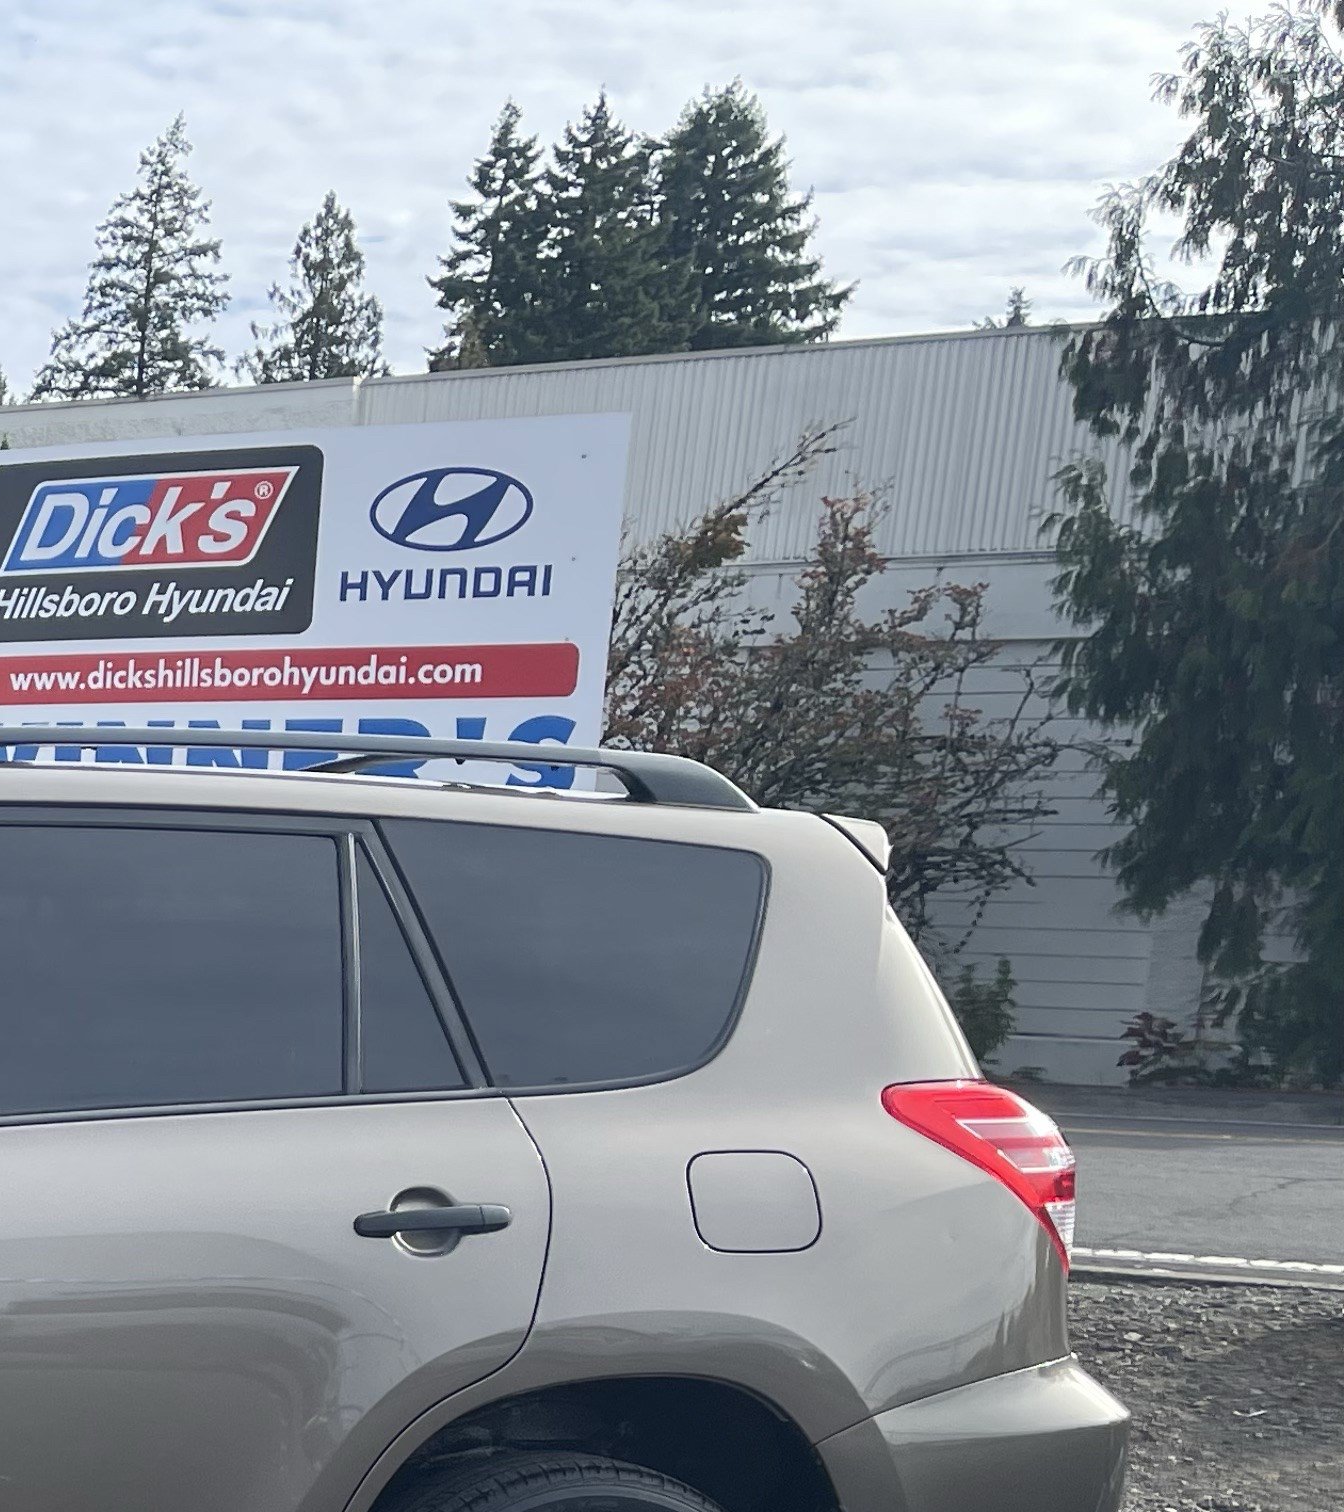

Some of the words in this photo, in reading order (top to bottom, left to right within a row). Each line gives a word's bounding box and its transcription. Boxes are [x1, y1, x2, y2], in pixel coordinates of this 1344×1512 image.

[143, 577, 295, 624] Hyundai
[340, 564, 552, 602] HYUNDAI
[9, 652, 482, 696] www.dickshillsborohyundai.com
